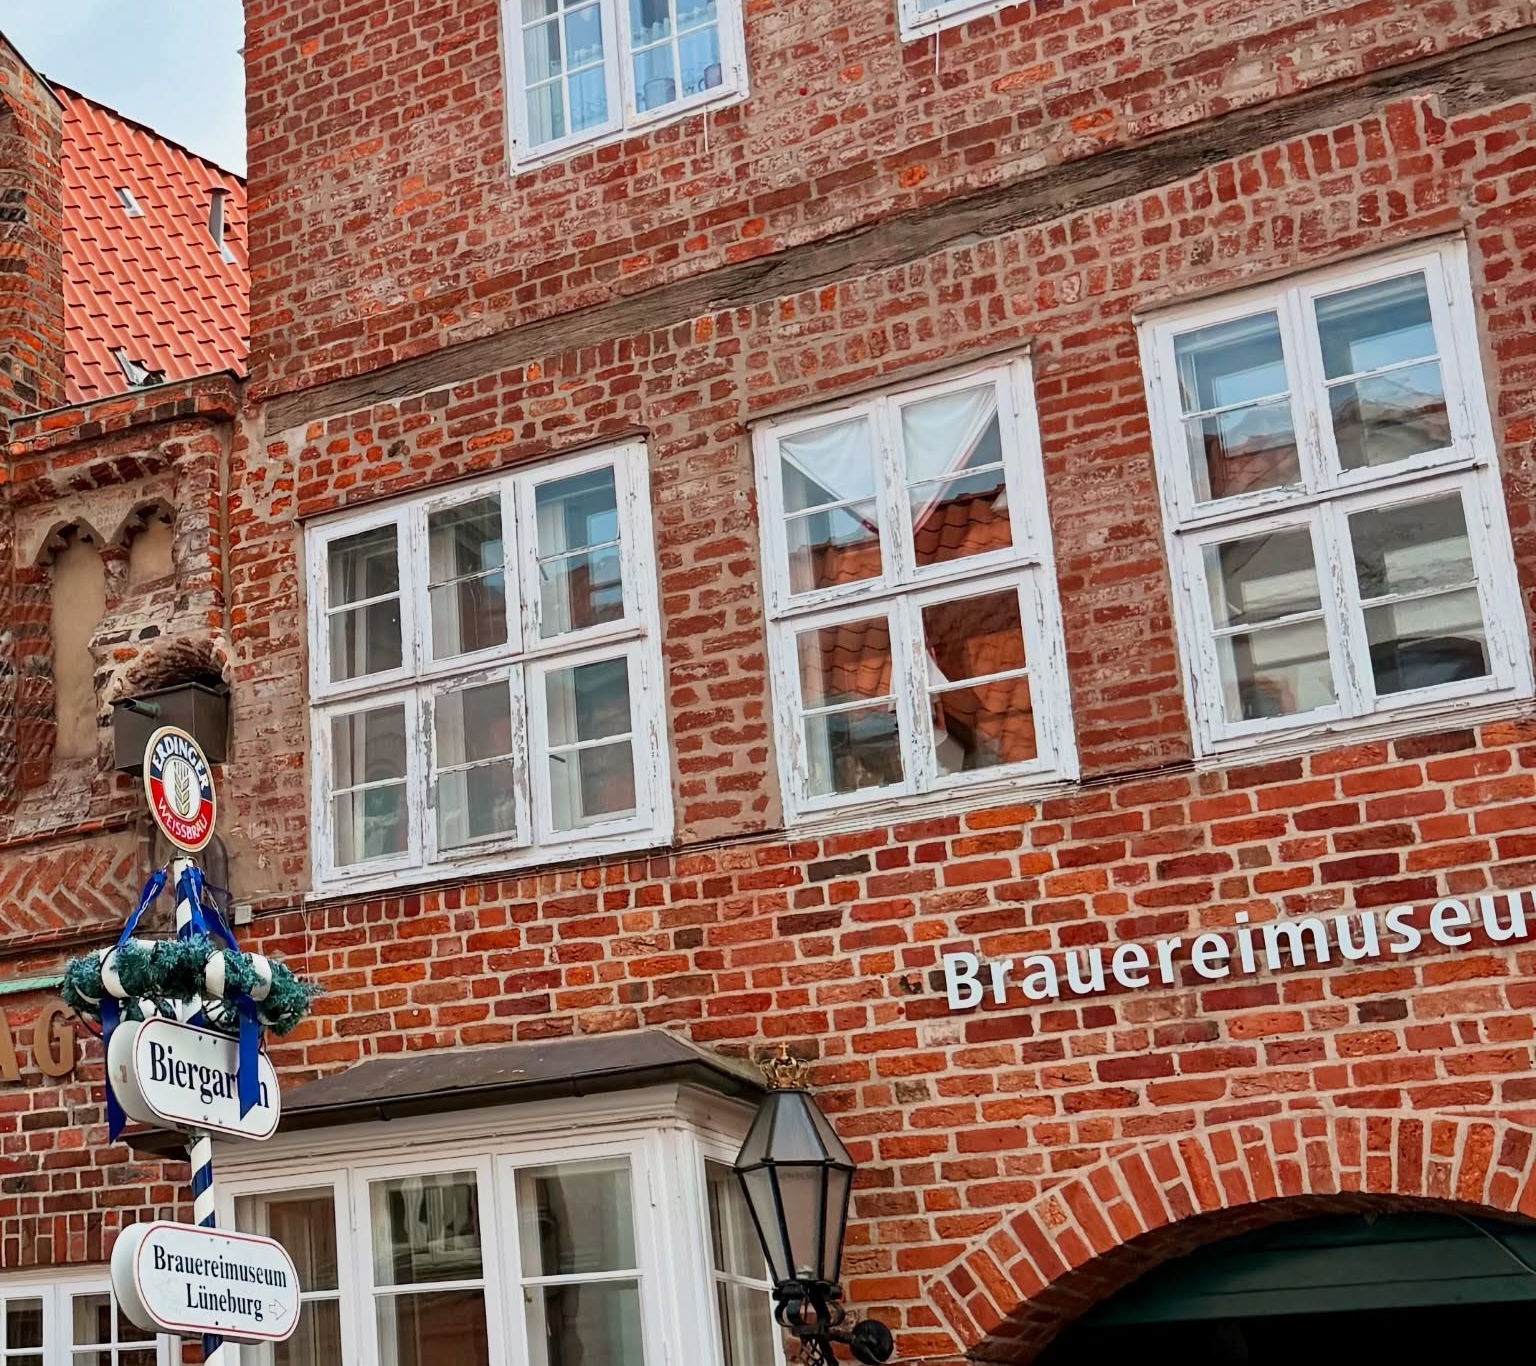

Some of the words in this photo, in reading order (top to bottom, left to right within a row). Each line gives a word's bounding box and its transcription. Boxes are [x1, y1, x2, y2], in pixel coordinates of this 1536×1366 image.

[151, 735, 210, 790] ERDINGER
[941, 890, 1536, 1011] Brauereimuseu
[149, 1041, 270, 1110] Biergarn
[152, 1244, 287, 1288] Brauereimuseum
[185, 1282, 264, 1322] Lüneburg
